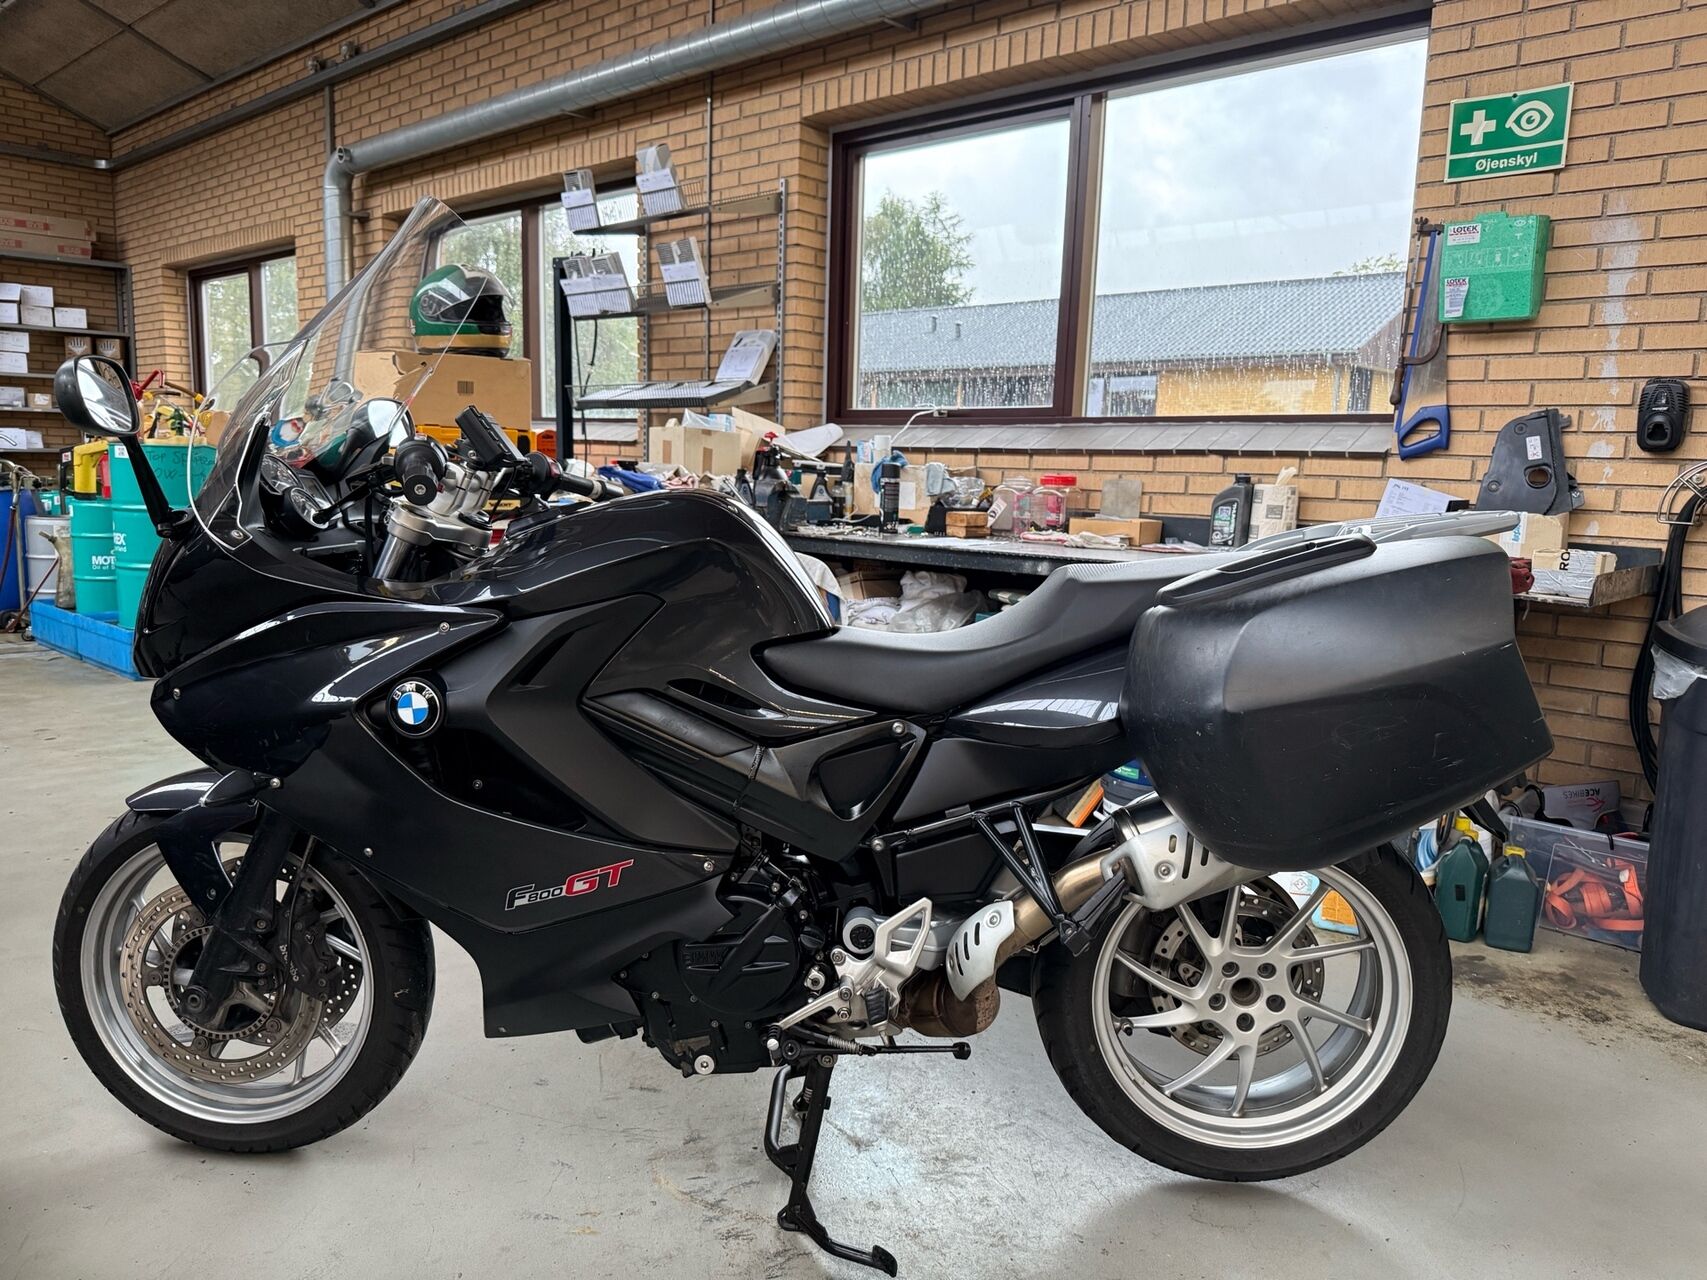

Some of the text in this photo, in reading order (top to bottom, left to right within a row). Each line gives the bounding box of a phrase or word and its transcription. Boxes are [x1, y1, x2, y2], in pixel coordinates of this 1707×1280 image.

[1475, 151, 1538, 173] Øjenskyl
[1452, 225, 1478, 234] LOTEK
[91, 556, 116, 565] MOT
[392, 683, 434, 701] BMW
[1562, 788, 1600, 799] ACEBIKES
